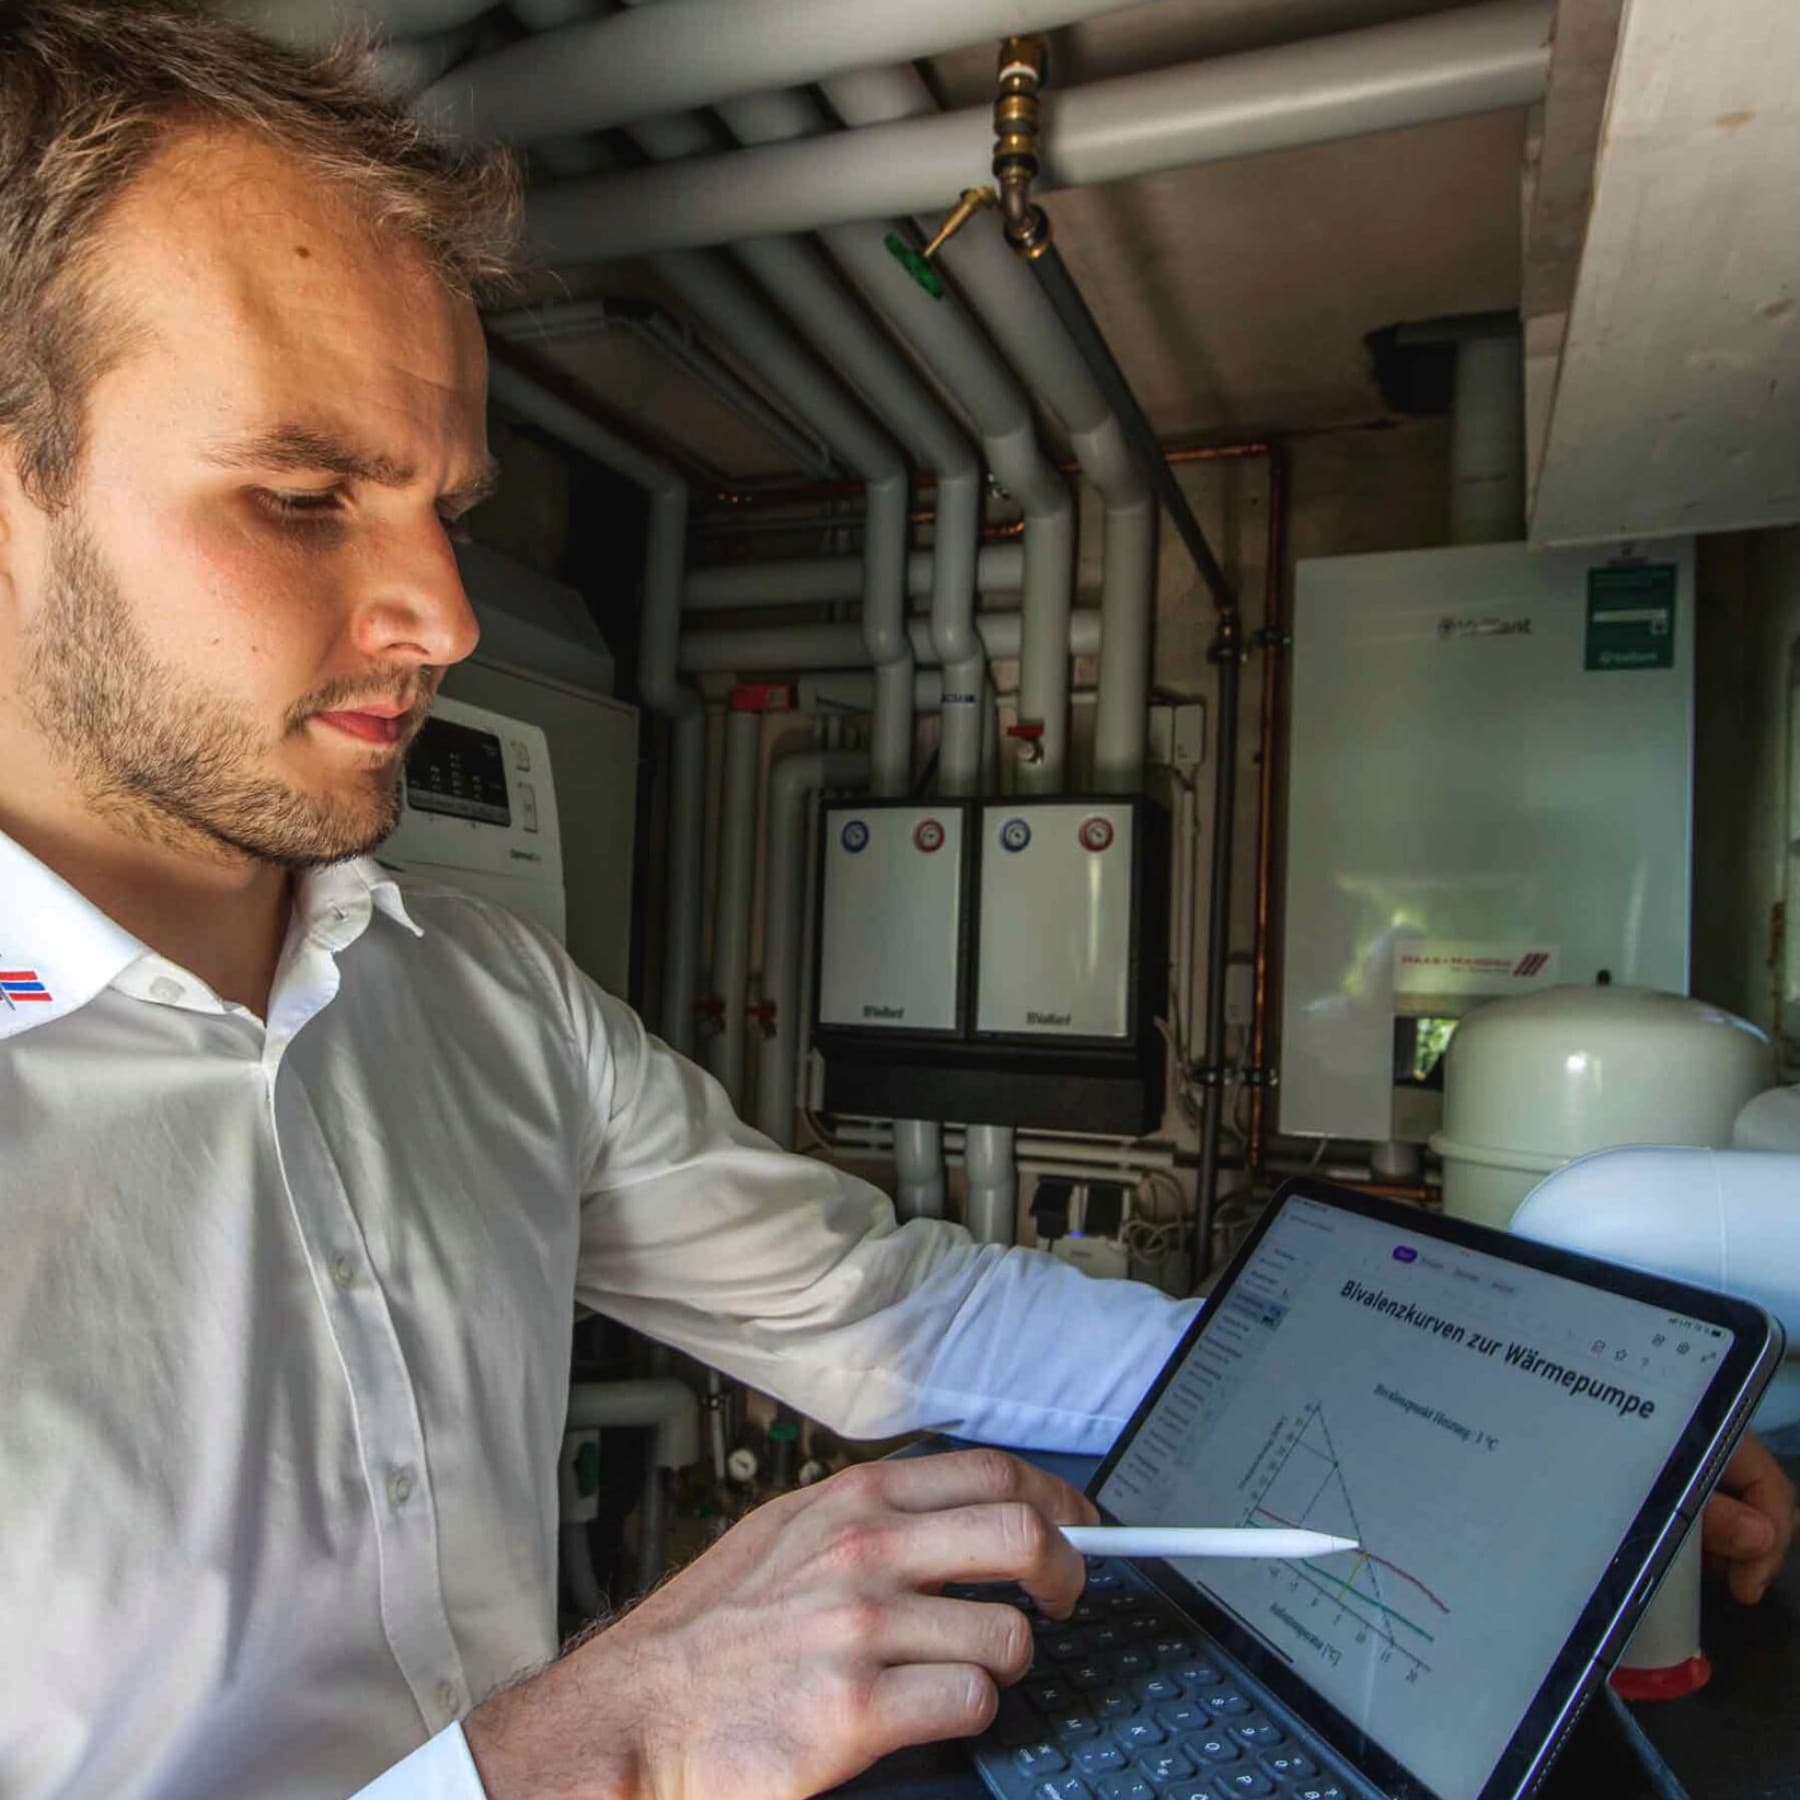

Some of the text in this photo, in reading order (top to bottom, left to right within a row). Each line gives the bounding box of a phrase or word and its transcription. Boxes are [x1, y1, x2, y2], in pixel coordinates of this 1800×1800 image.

[1340, 1279, 1656, 1420] Bivalenzkurven zur Wärmepumpe
